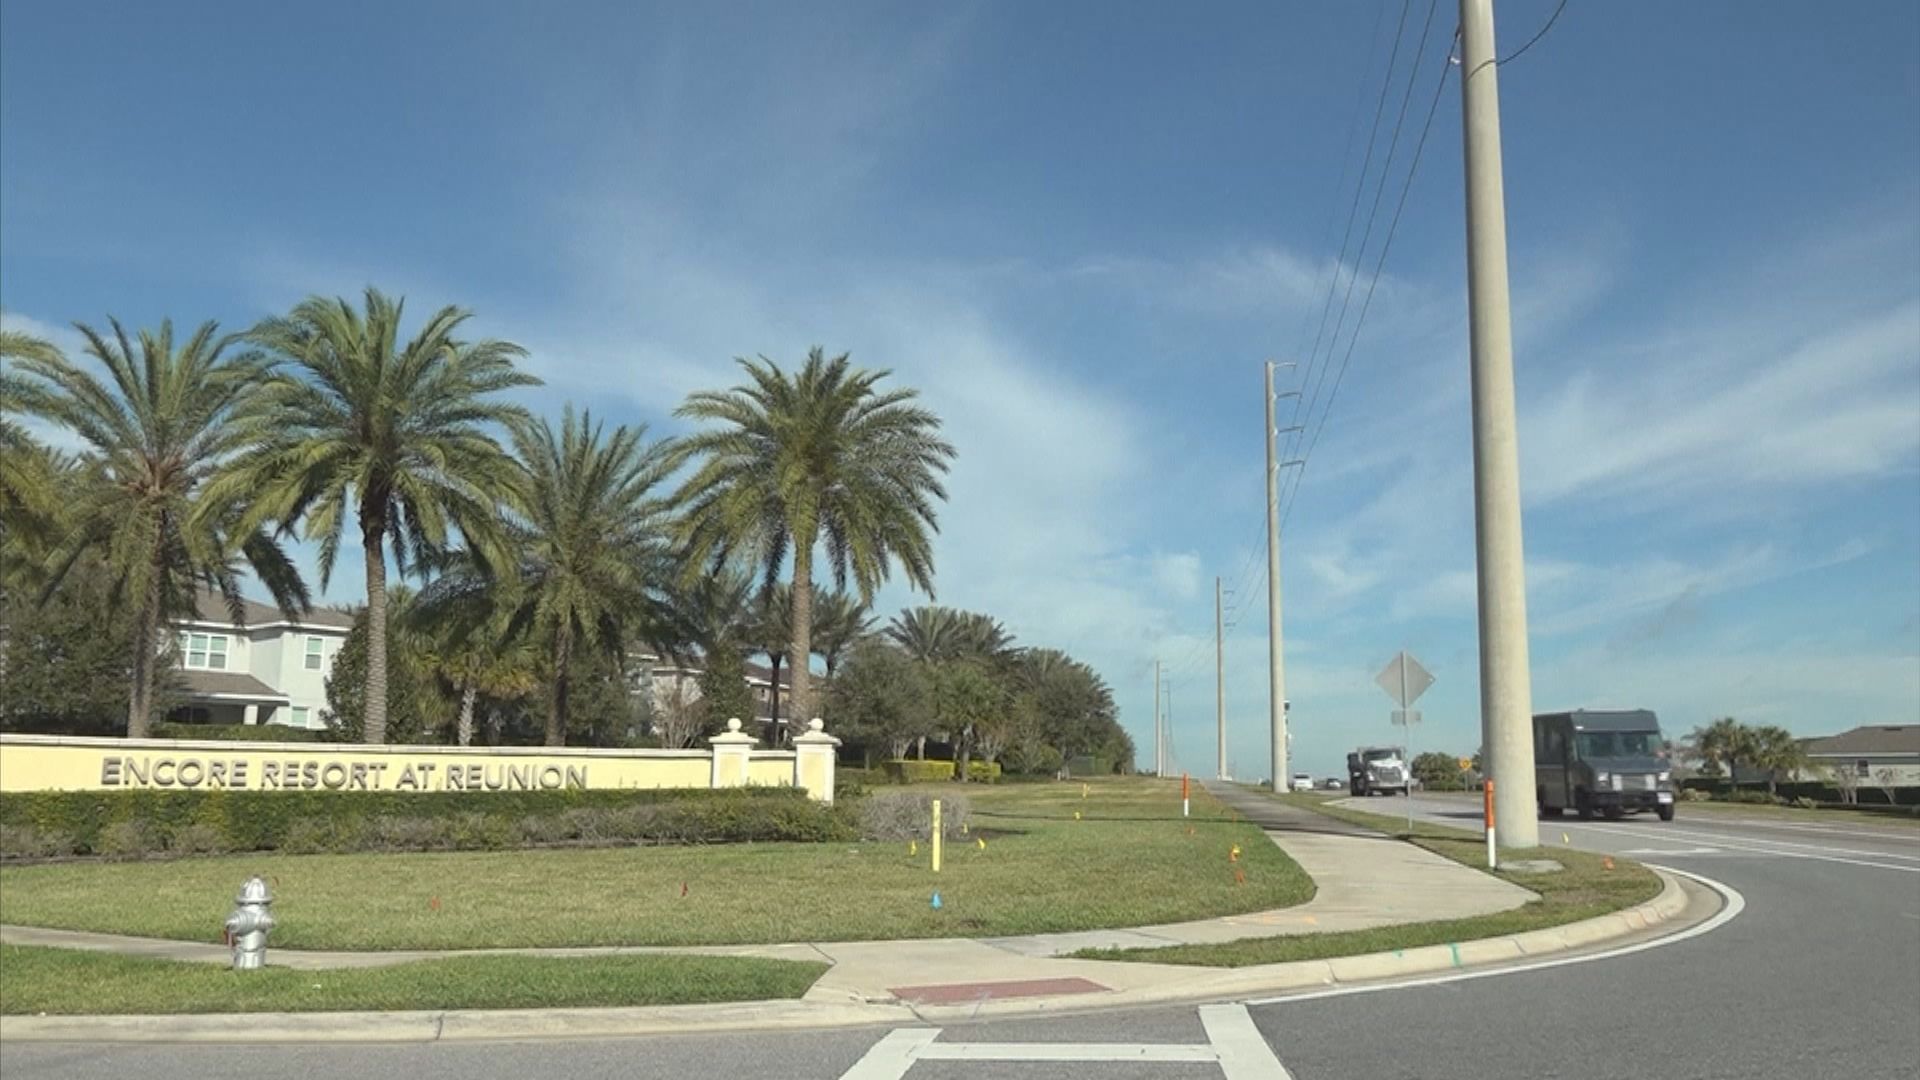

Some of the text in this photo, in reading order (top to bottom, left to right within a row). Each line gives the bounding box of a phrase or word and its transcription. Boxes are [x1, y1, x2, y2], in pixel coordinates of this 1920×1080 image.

[101, 757, 588, 790] ENCORE RESORT AT REUNION
